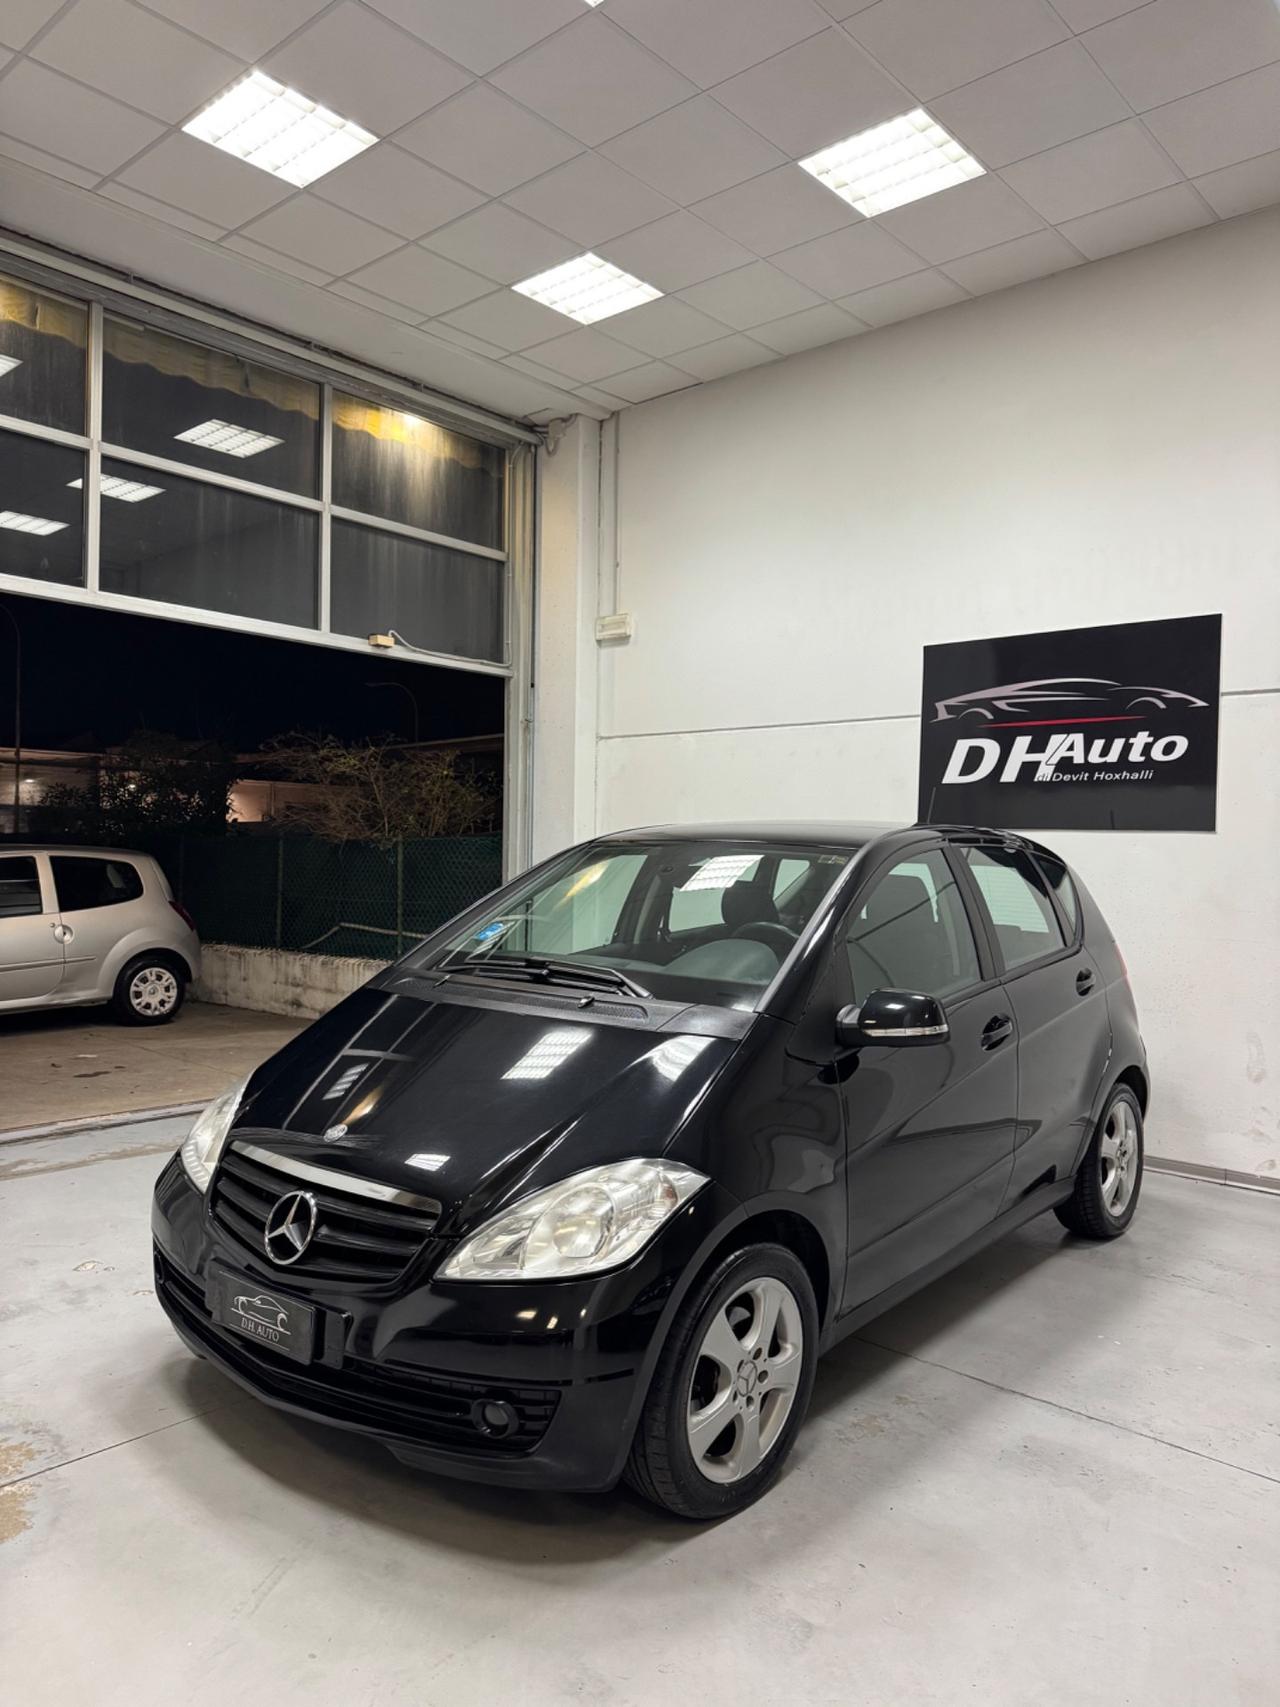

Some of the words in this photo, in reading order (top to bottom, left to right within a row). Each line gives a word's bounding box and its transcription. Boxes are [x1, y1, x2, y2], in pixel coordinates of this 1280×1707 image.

[1052, 771, 1089, 782] Devit
[1093, 769, 1154, 781] Hoxhalli
[256, 1324, 280, 1342] AUTO
